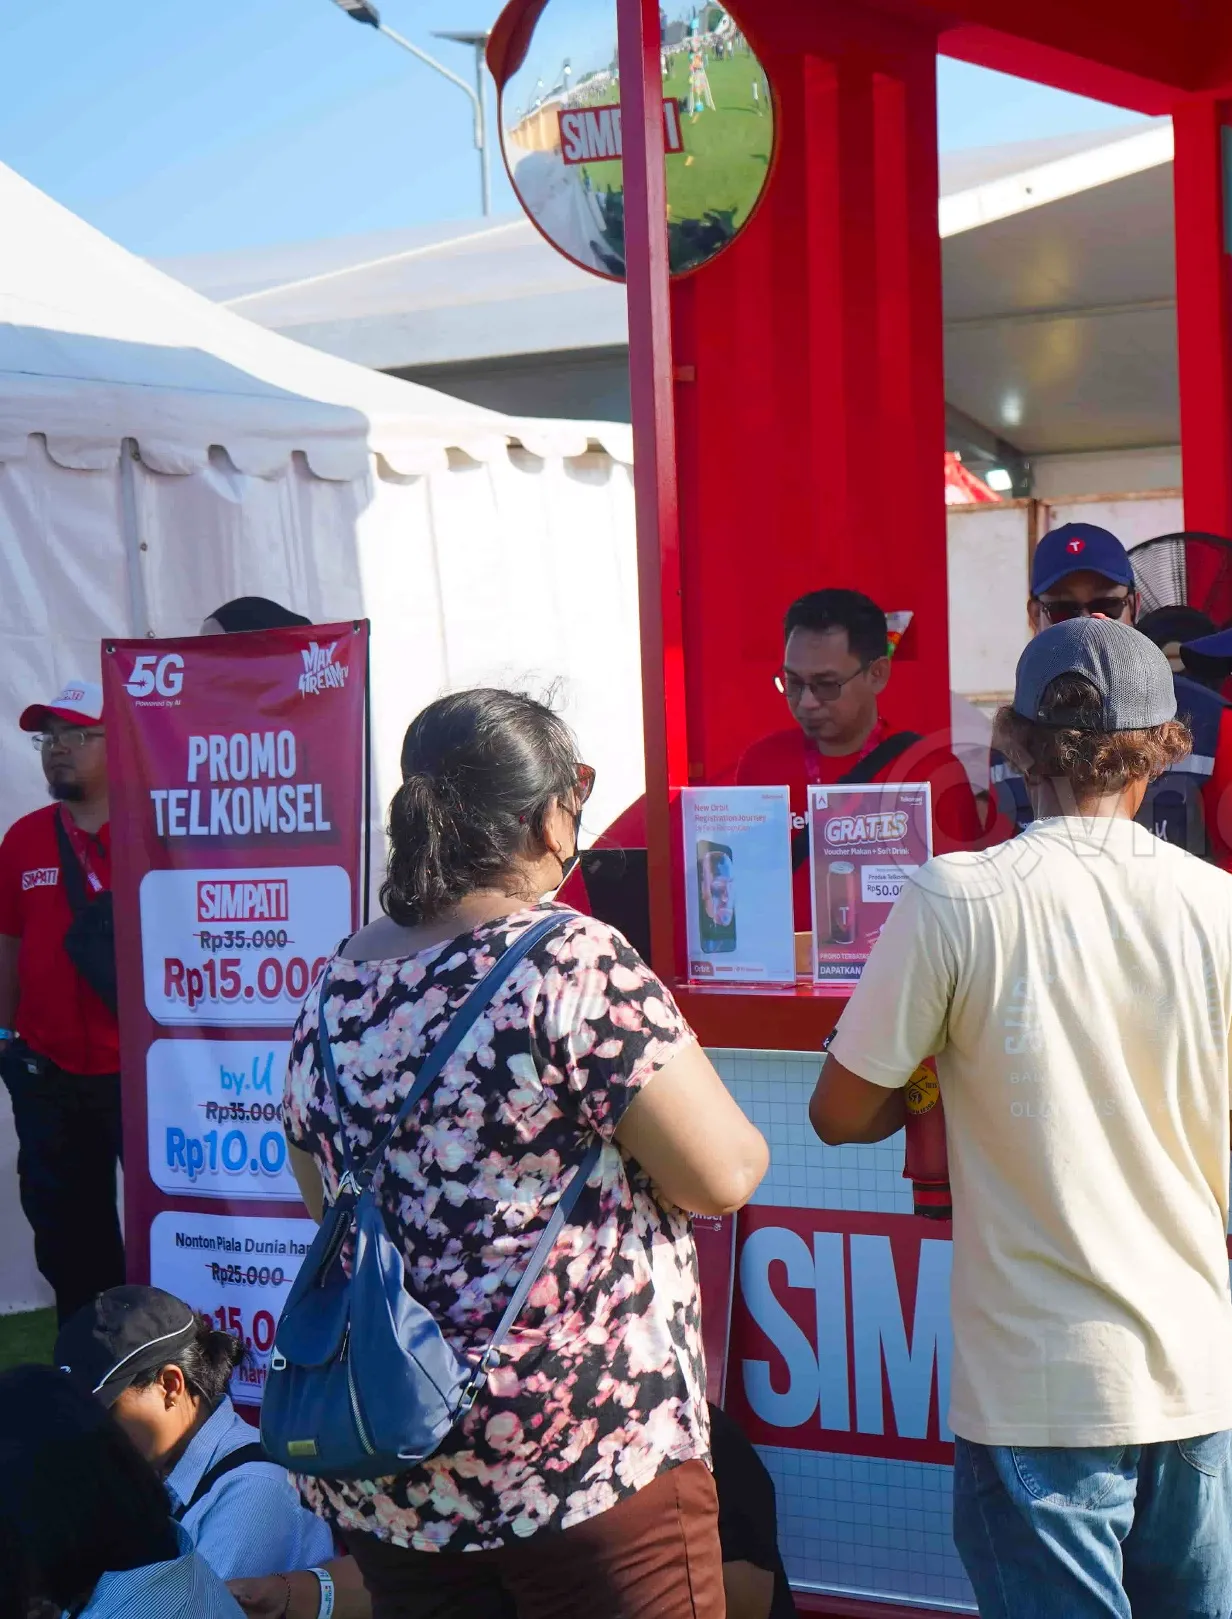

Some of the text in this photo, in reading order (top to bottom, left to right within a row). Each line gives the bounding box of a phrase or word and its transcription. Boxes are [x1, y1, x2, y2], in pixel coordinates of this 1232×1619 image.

[561, 102, 680, 161] SIMPI
[301, 641, 338, 673] MAX
[127, 653, 185, 698] 5G
[298, 661, 346, 699] STREAM
[135, 700, 165, 708] Powered
[187, 729, 296, 783] PROMO
[150, 784, 331, 837] TELKOMSEL
[694, 803, 729, 812] New Orbit
[825, 811, 908, 846] GRATIS
[824, 848, 850, 856] Voucher
[877, 847, 892, 855] Soft
[892, 847, 910, 855] Drink
[199, 882, 287, 920] SIMPATI
[200, 929, 288, 953] Rp35.000
[820, 966, 861, 975] DAPATKAN
[166, 1127, 286, 1178] Rp10.0
[175, 1232, 313, 1255] Nonton Piala Dunia har
[211, 1261, 286, 1287] Rp25.000
